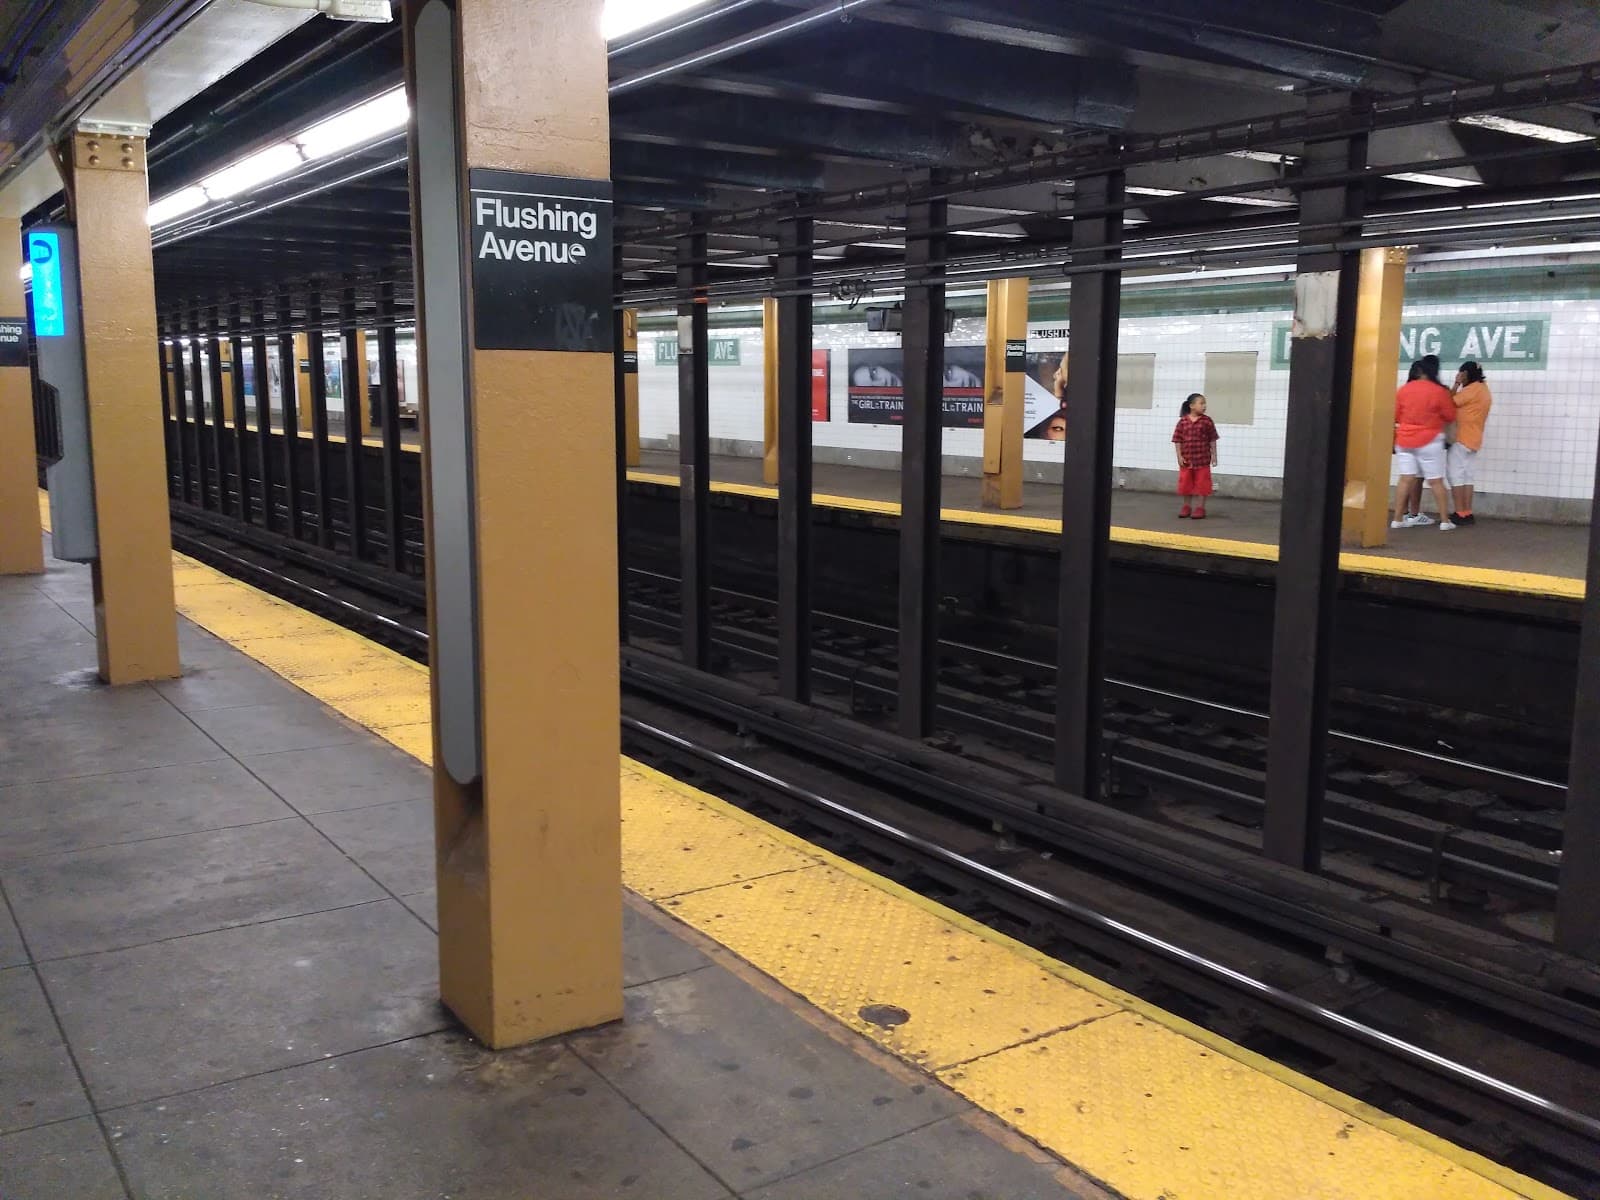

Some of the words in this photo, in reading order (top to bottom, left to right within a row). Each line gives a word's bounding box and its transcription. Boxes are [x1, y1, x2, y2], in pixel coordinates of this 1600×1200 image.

[476, 197, 597, 240] Flushing
[478, 231, 587, 265] Avenue
[1458, 325, 1534, 359] AVE.
[879, 400, 904, 411] TRAIN
[954, 402, 984, 413] TRAIN
